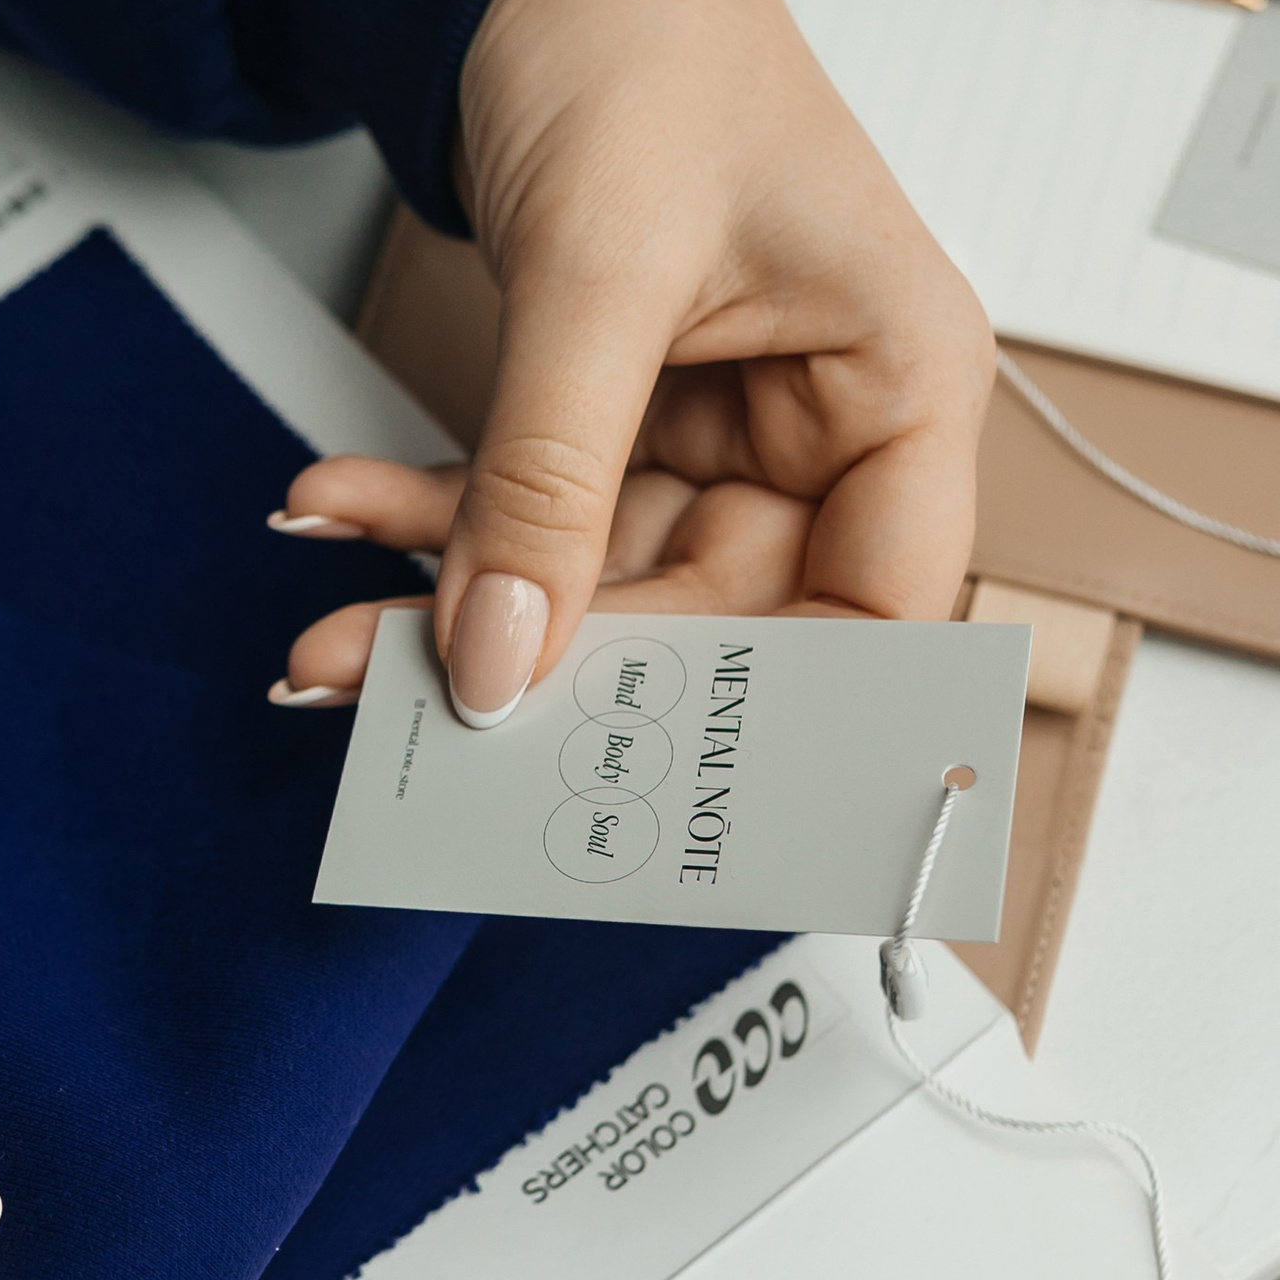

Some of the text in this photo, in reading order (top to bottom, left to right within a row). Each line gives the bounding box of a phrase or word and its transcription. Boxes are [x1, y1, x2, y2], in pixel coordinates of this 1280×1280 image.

[614, 656, 648, 710] Mind
[697, 642, 754, 778] MENTAL
[593, 732, 634, 784] Body
[586, 811, 620, 859] Soul
[522, 1083, 670, 1205] CATCHERS
[598, 1109, 696, 1192] COLOR
